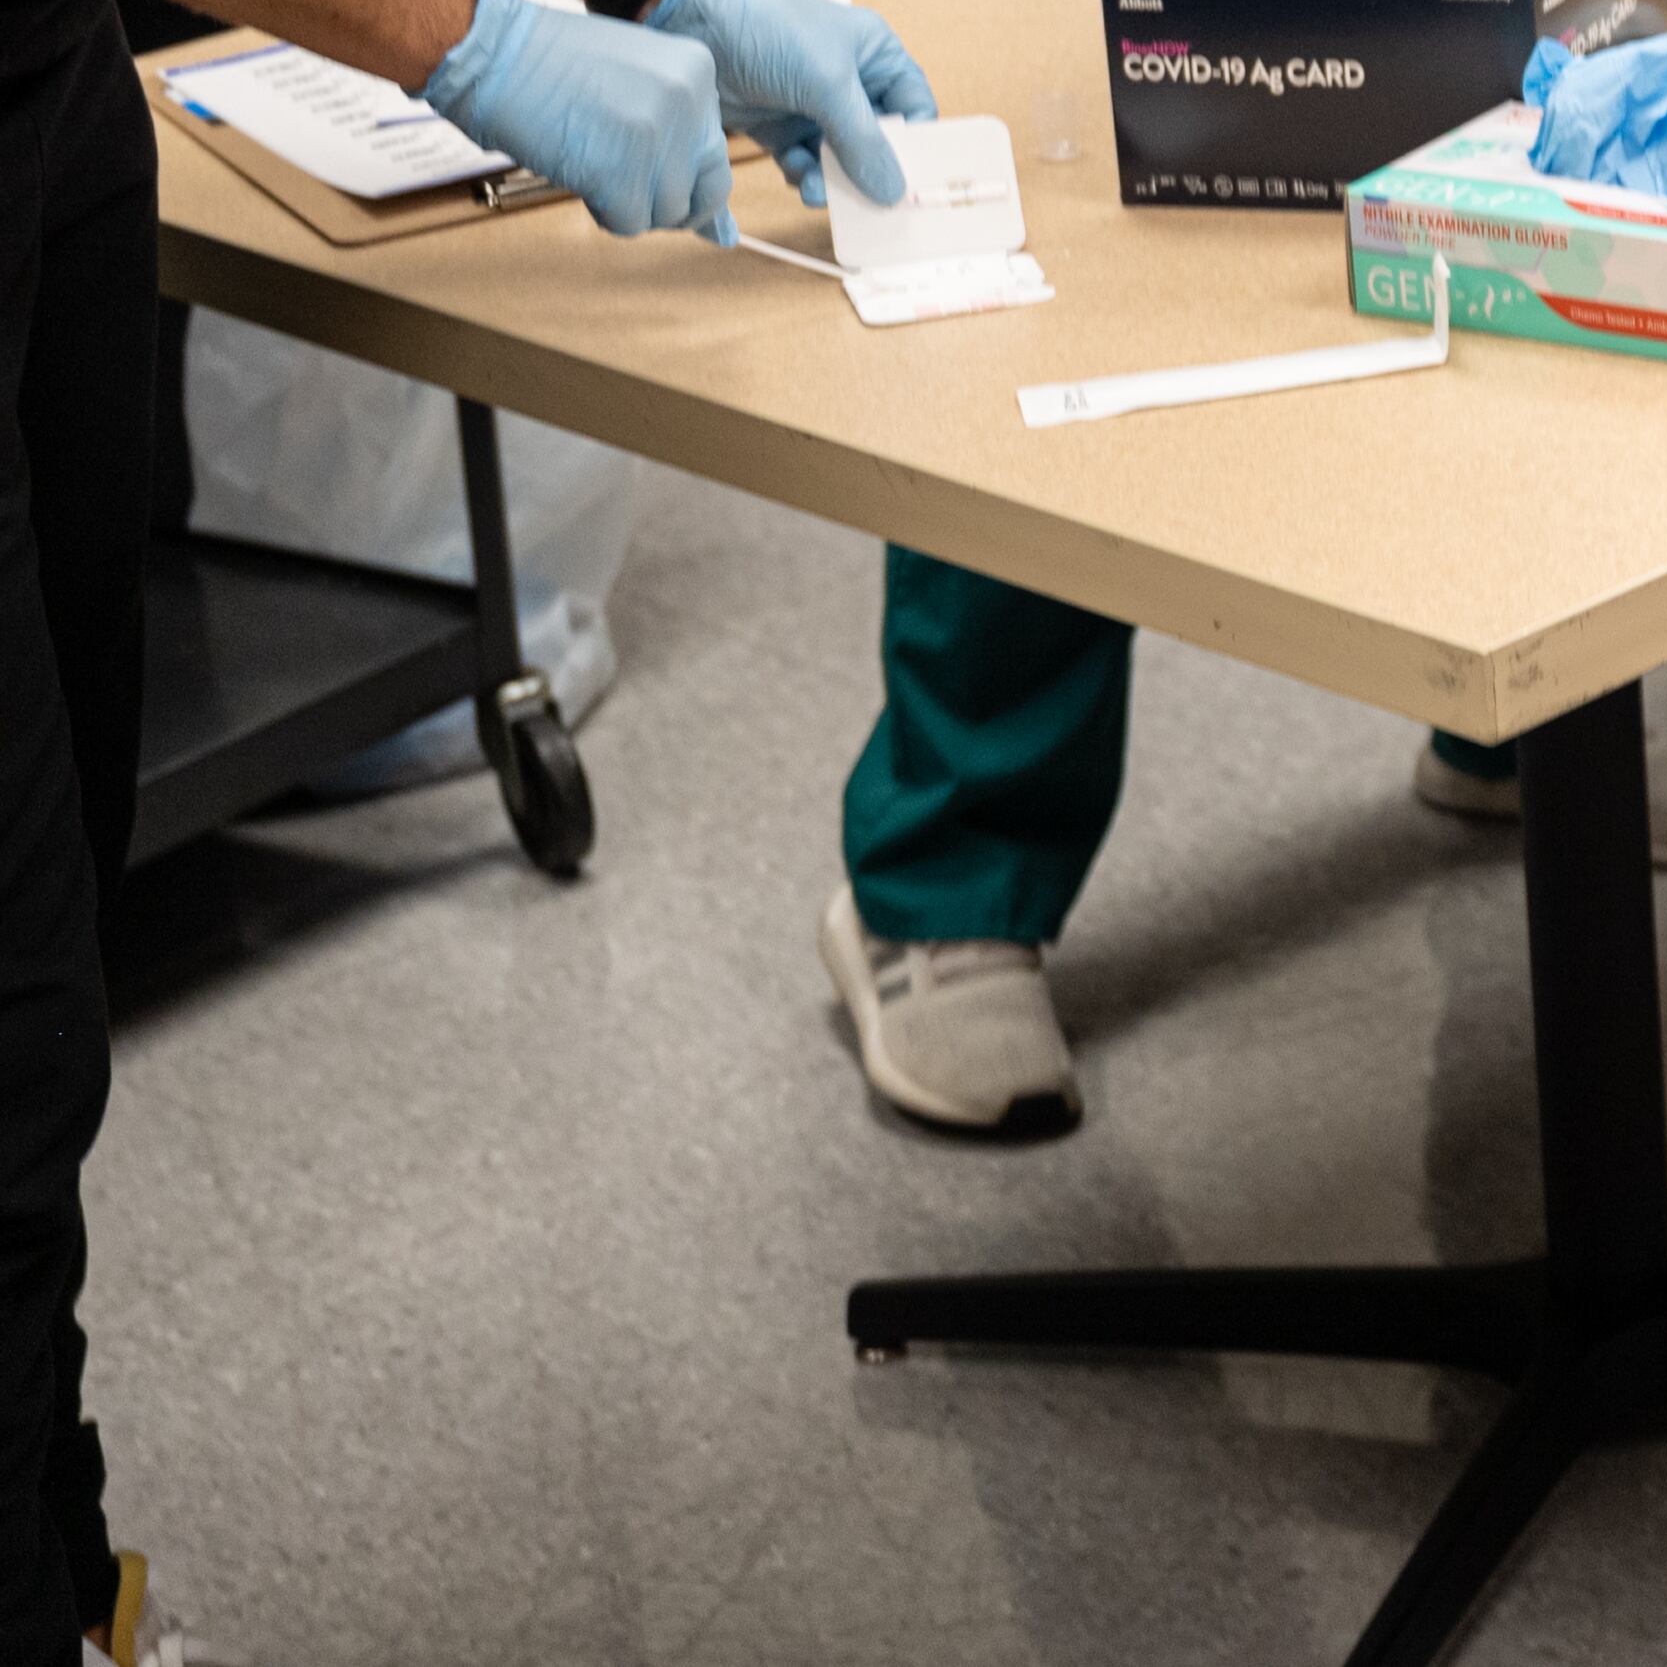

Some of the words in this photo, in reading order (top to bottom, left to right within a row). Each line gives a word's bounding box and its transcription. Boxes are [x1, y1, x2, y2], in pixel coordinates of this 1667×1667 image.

[1121, 39, 1190, 56] BinaxNOW
[1122, 54, 1246, 87] COVID-19
[1249, 57, 1285, 96] Ag
[1287, 59, 1366, 89] CARD
[1363, 203, 1414, 225] NITRILE
[1417, 212, 1511, 243] EXAMINATION
[1514, 227, 1569, 252] GLOVES
